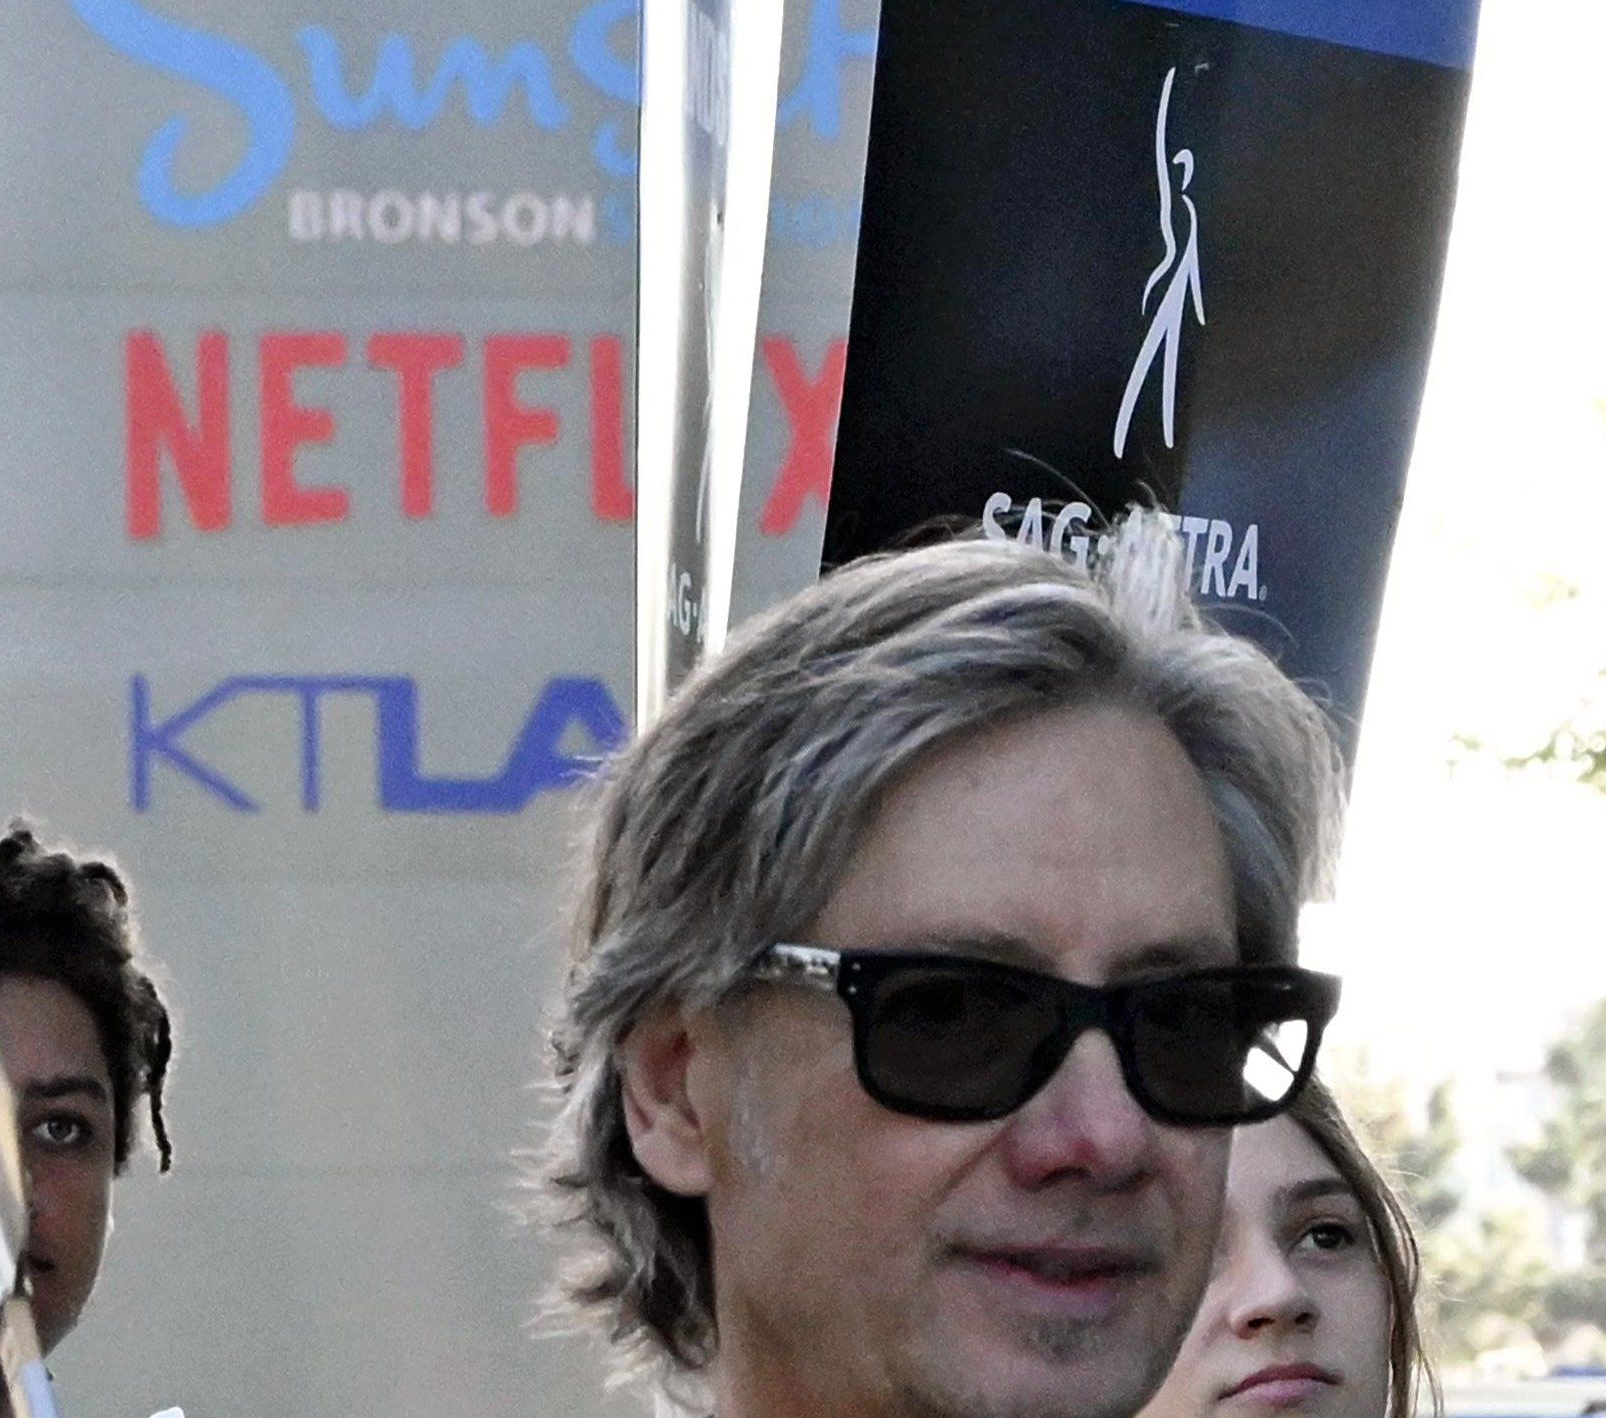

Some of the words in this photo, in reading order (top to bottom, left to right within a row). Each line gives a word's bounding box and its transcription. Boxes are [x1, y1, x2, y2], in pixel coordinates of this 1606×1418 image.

[288, 189, 595, 246] BRONSON
[125, 330, 849, 540] NETFLX
[131, 673, 630, 813] KTLA
